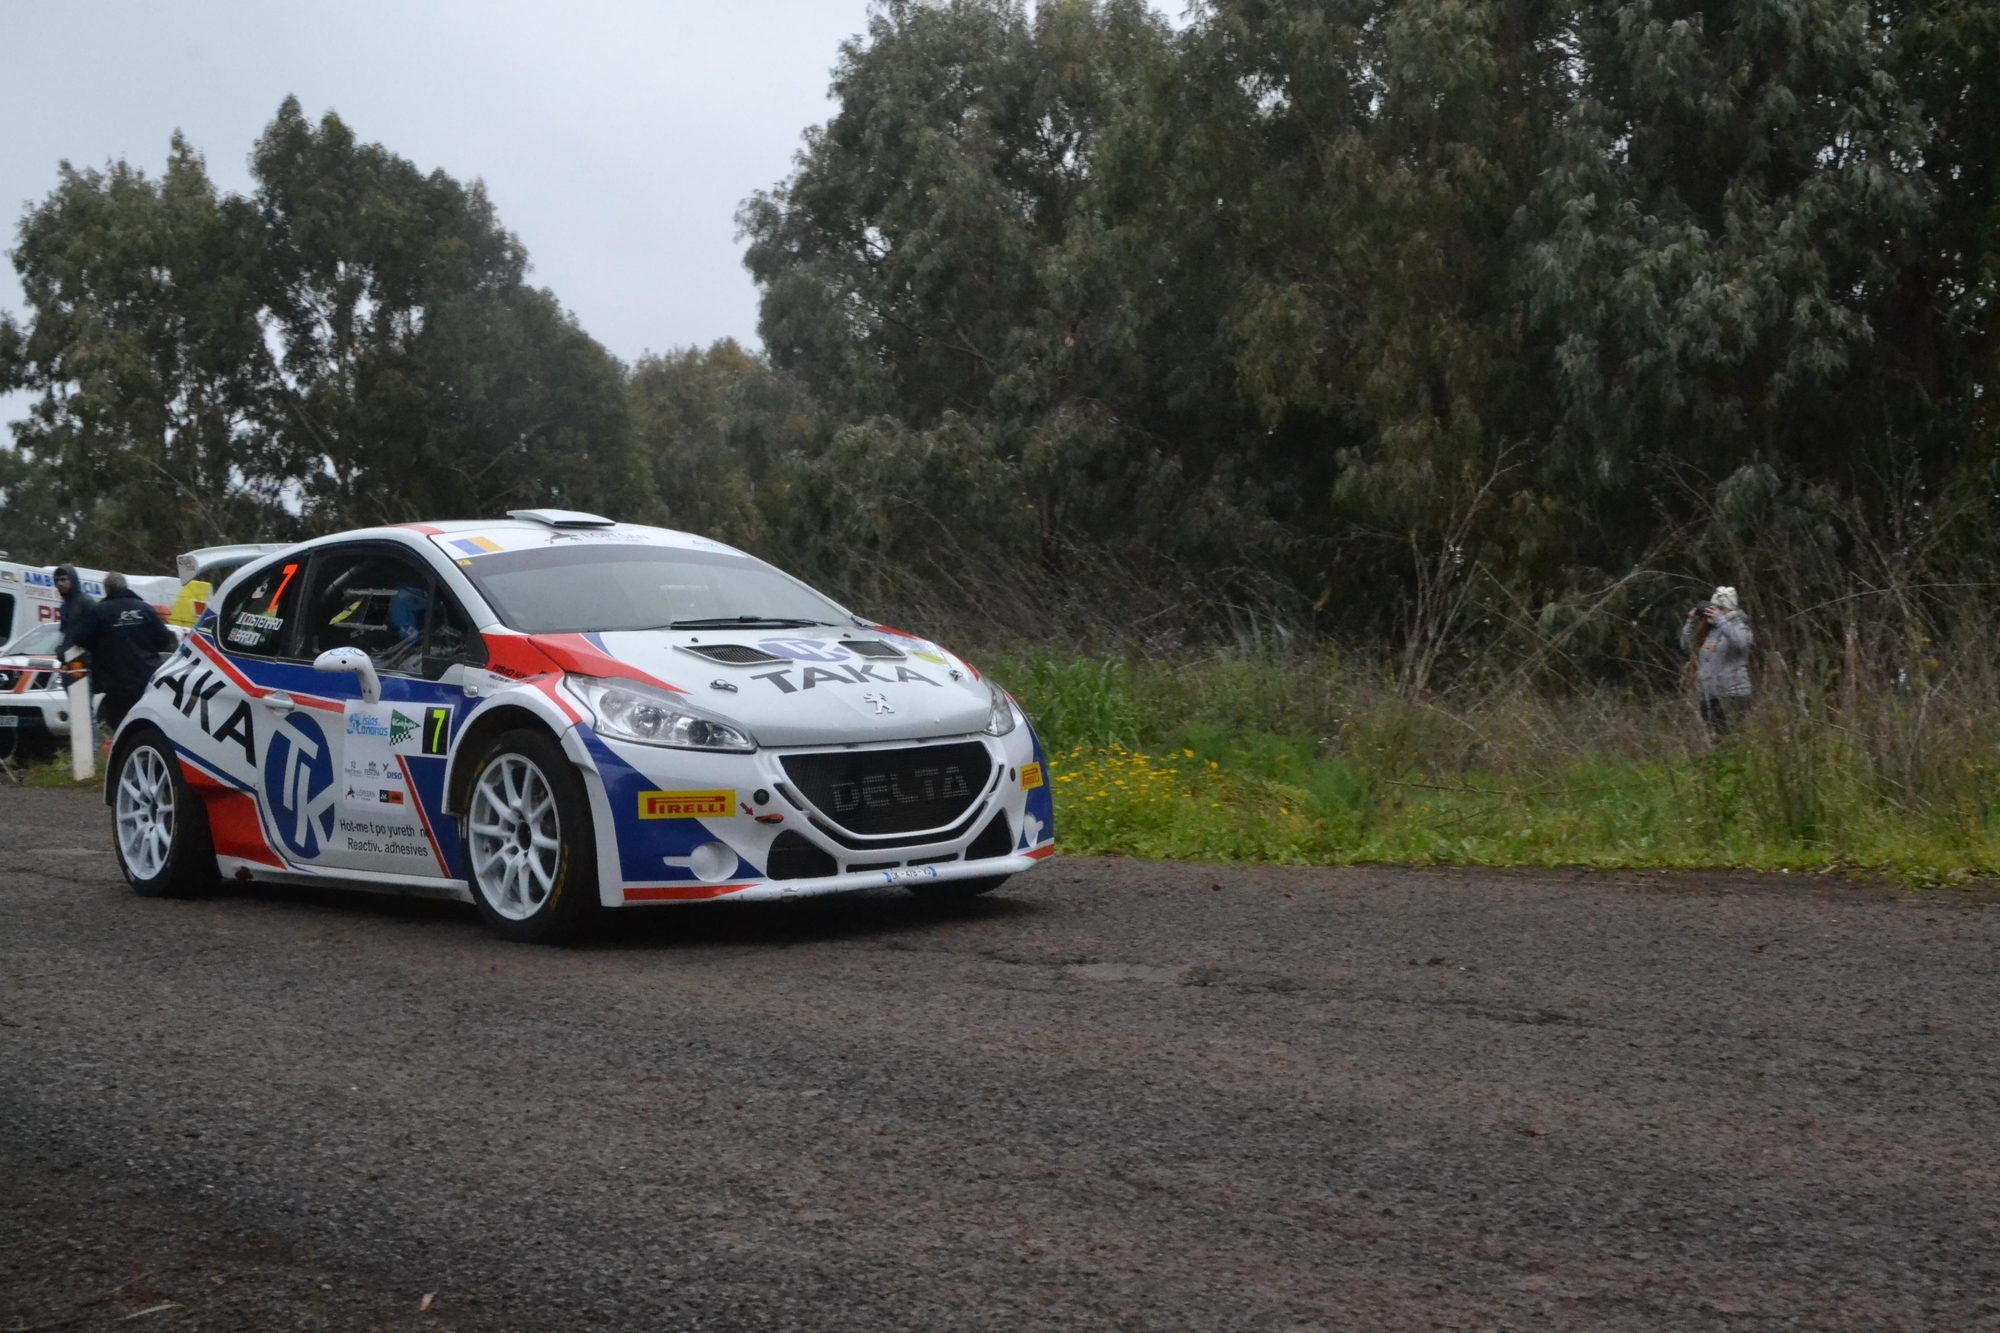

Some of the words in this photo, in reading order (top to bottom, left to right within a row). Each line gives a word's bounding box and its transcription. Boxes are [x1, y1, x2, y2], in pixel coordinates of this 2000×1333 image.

[267, 564, 299, 613] 7
[750, 664, 944, 694] TAKA
[432, 709, 446, 753] 7
[647, 796, 726, 814] PIRELLI
[830, 766, 971, 812] DELTA
[385, 842, 428, 857] adhesives
